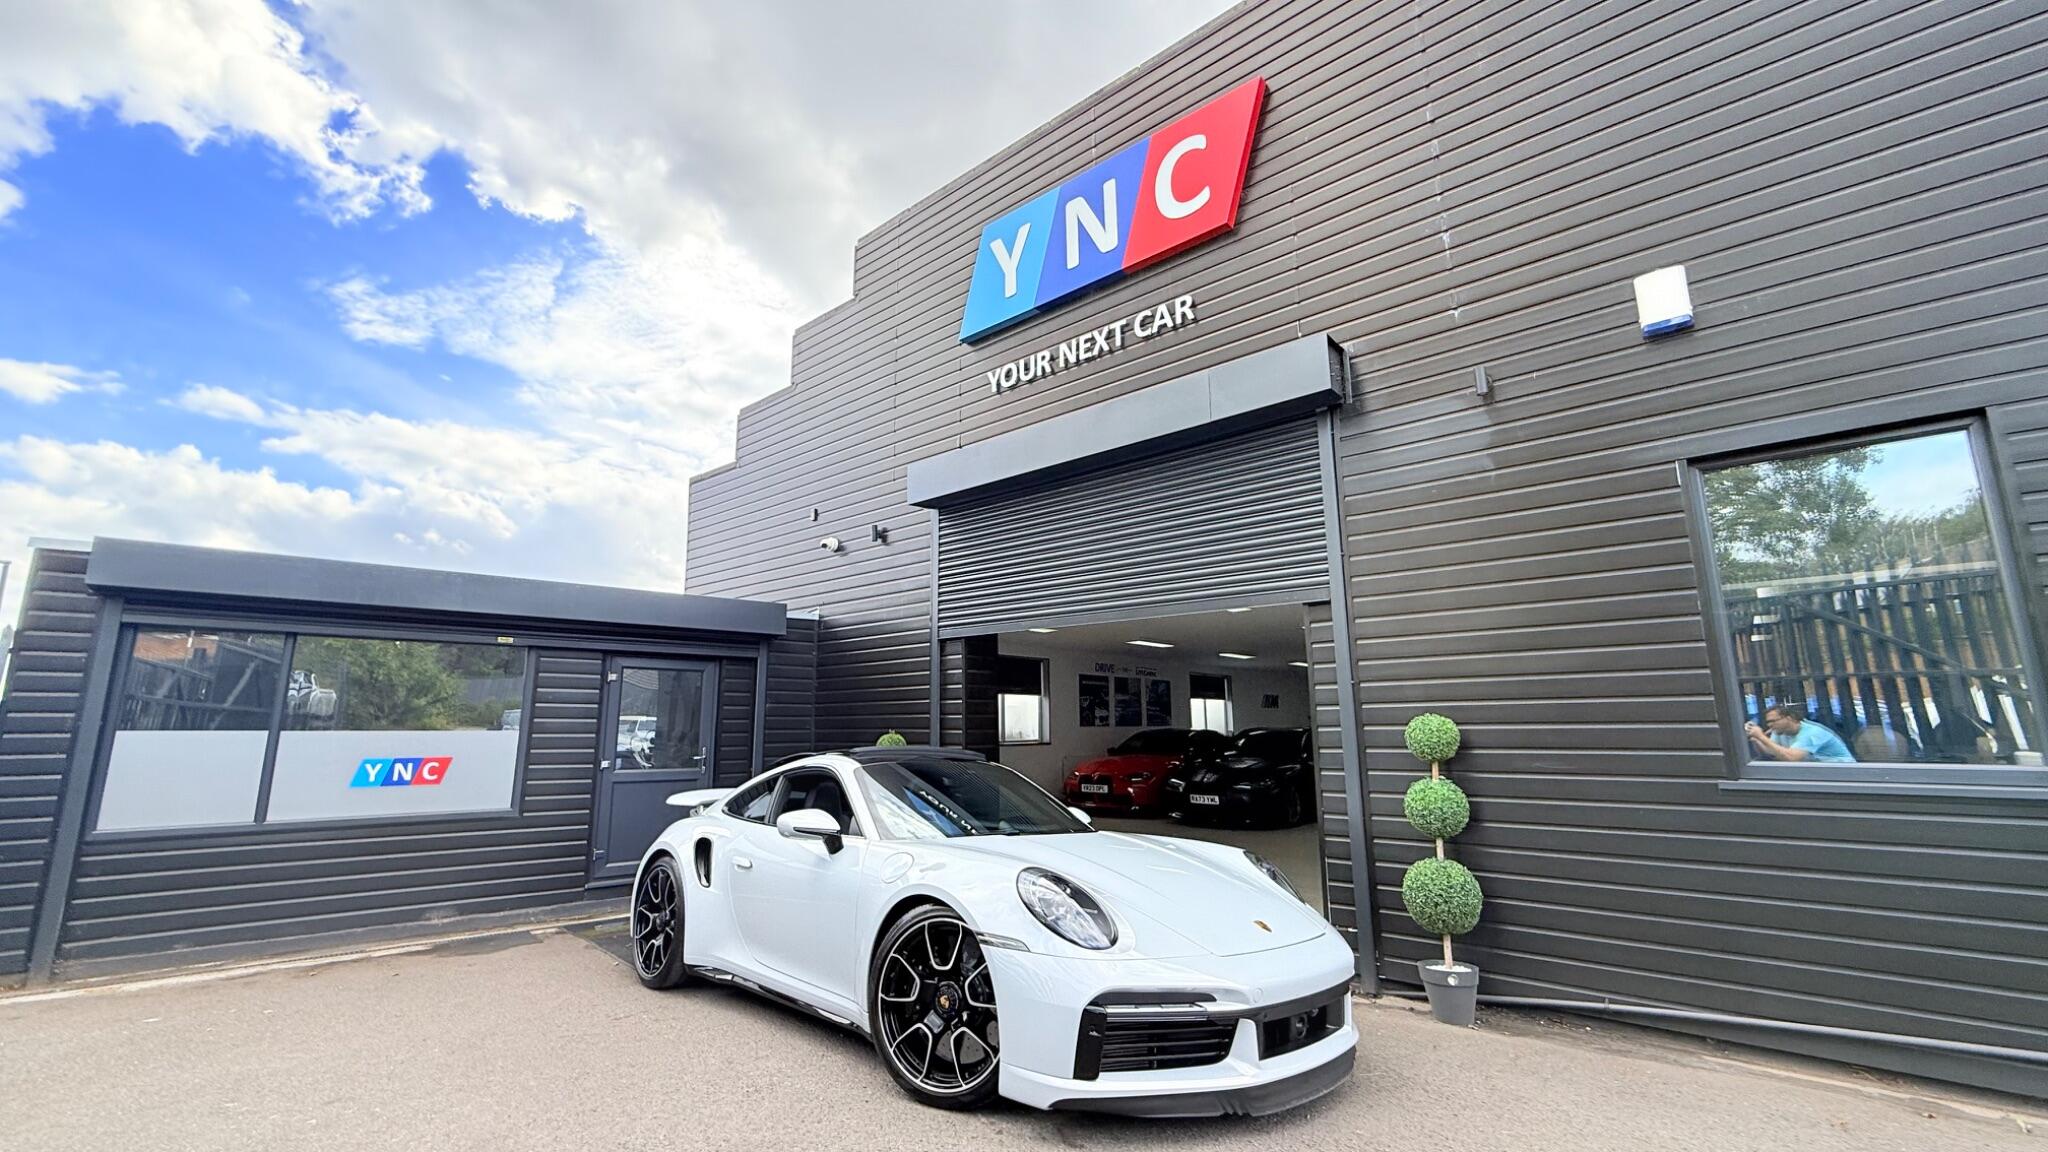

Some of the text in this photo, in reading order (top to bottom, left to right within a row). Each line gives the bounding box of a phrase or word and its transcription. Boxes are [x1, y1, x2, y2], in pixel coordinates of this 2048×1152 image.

[990, 134, 1210, 298] YNC
[987, 295, 1195, 392] YOUR NEXT CAR
[364, 761, 439, 782] YNC
